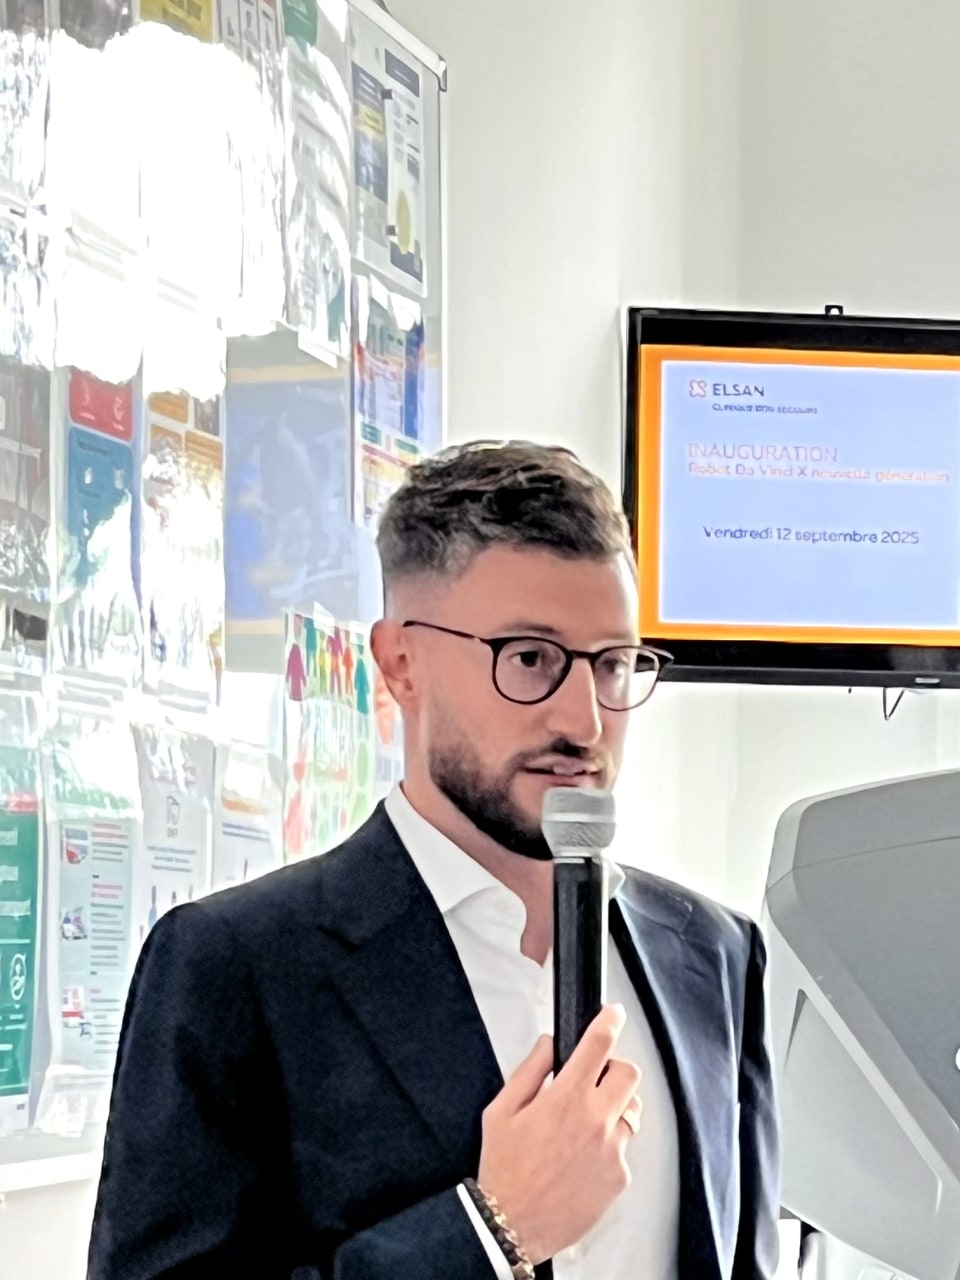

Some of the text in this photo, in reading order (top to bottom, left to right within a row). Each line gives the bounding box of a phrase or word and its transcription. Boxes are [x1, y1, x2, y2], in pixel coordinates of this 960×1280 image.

[712, 383, 765, 397] ELSAN
[688, 443, 838, 462] INAUGURATION
[688, 463, 730, 476] Robot
[735, 463, 754, 476] Da
[797, 466, 807, 477] X
[703, 526, 920, 544] Vendredi 12 septembre 2025
